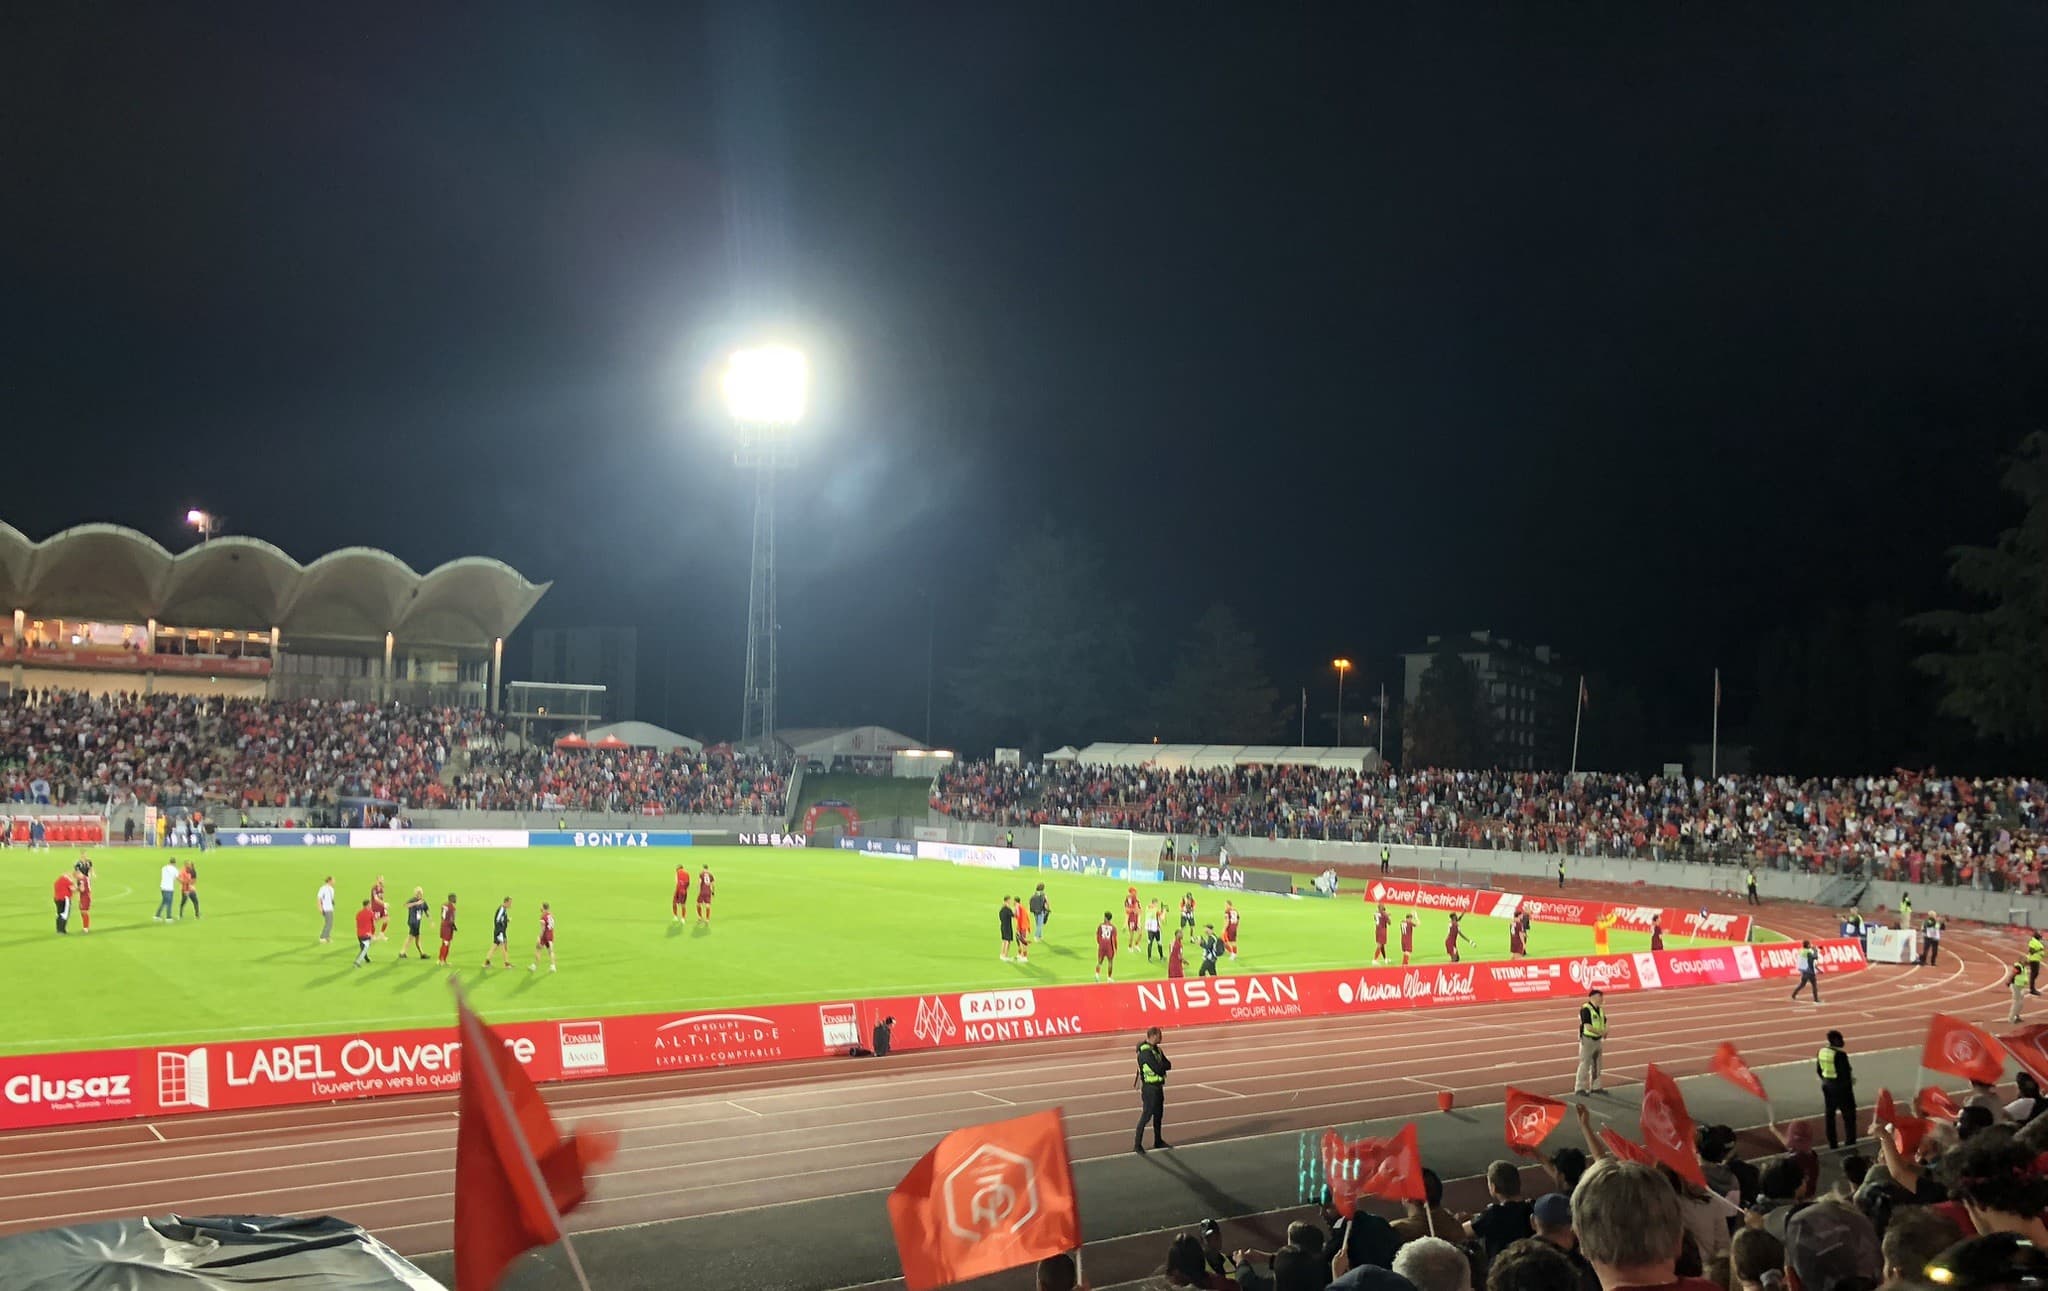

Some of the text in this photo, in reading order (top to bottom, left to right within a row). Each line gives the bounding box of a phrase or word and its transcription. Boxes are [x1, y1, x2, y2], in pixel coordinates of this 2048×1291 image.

[573, 832, 648, 847] BONTAZ
[738, 832, 807, 847] NISSAN
[1181, 864, 1244, 883] NISSAN
[1386, 886, 1415, 902] Duret
[1829, 944, 1862, 963] PAPA
[1669, 956, 1725, 974] Groupama
[1137, 975, 1299, 1012] NISSAN
[970, 997, 1026, 1013] RADIO
[1231, 1003, 1301, 1018] GROUPE MAURIN
[693, 1022, 740, 1032] GROUPE
[965, 1015, 1082, 1042] MONT BLANC
[226, 1044, 336, 1087] LABEL
[4, 1074, 131, 1104] Clusaz
[312, 1077, 384, 1096] l'ouverture
[385, 1076, 413, 1089] vers
[415, 1074, 427, 1086] la
